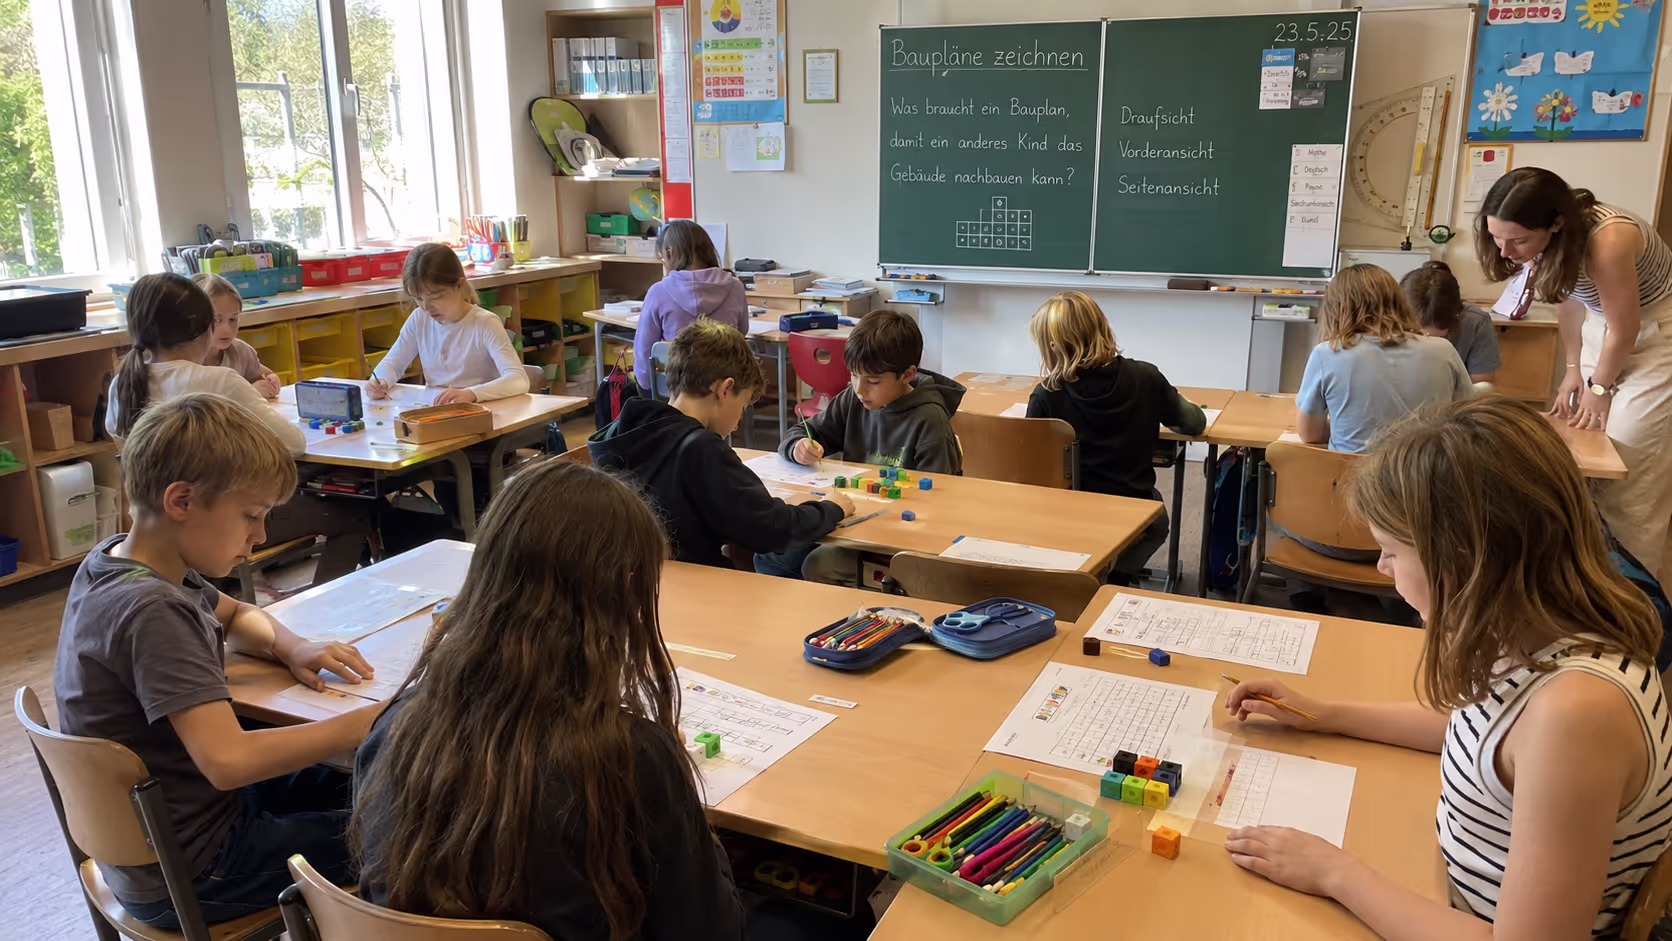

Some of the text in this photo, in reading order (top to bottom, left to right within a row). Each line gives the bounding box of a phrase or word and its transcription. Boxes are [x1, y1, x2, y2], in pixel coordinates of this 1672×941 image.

[892, 38, 1084, 77] Baupläne zeichnen
[891, 97, 1070, 123] Was braucht ein Bauplan,
[1120, 105, 1195, 131] Draufsicht
[889, 131, 1083, 152] damit ein anderes Kind das
[1118, 140, 1215, 159] Vorderansicht
[890, 163, 1075, 186] Gebäude nachbauen kann?
[1118, 174, 1220, 196] Seitenansicht
